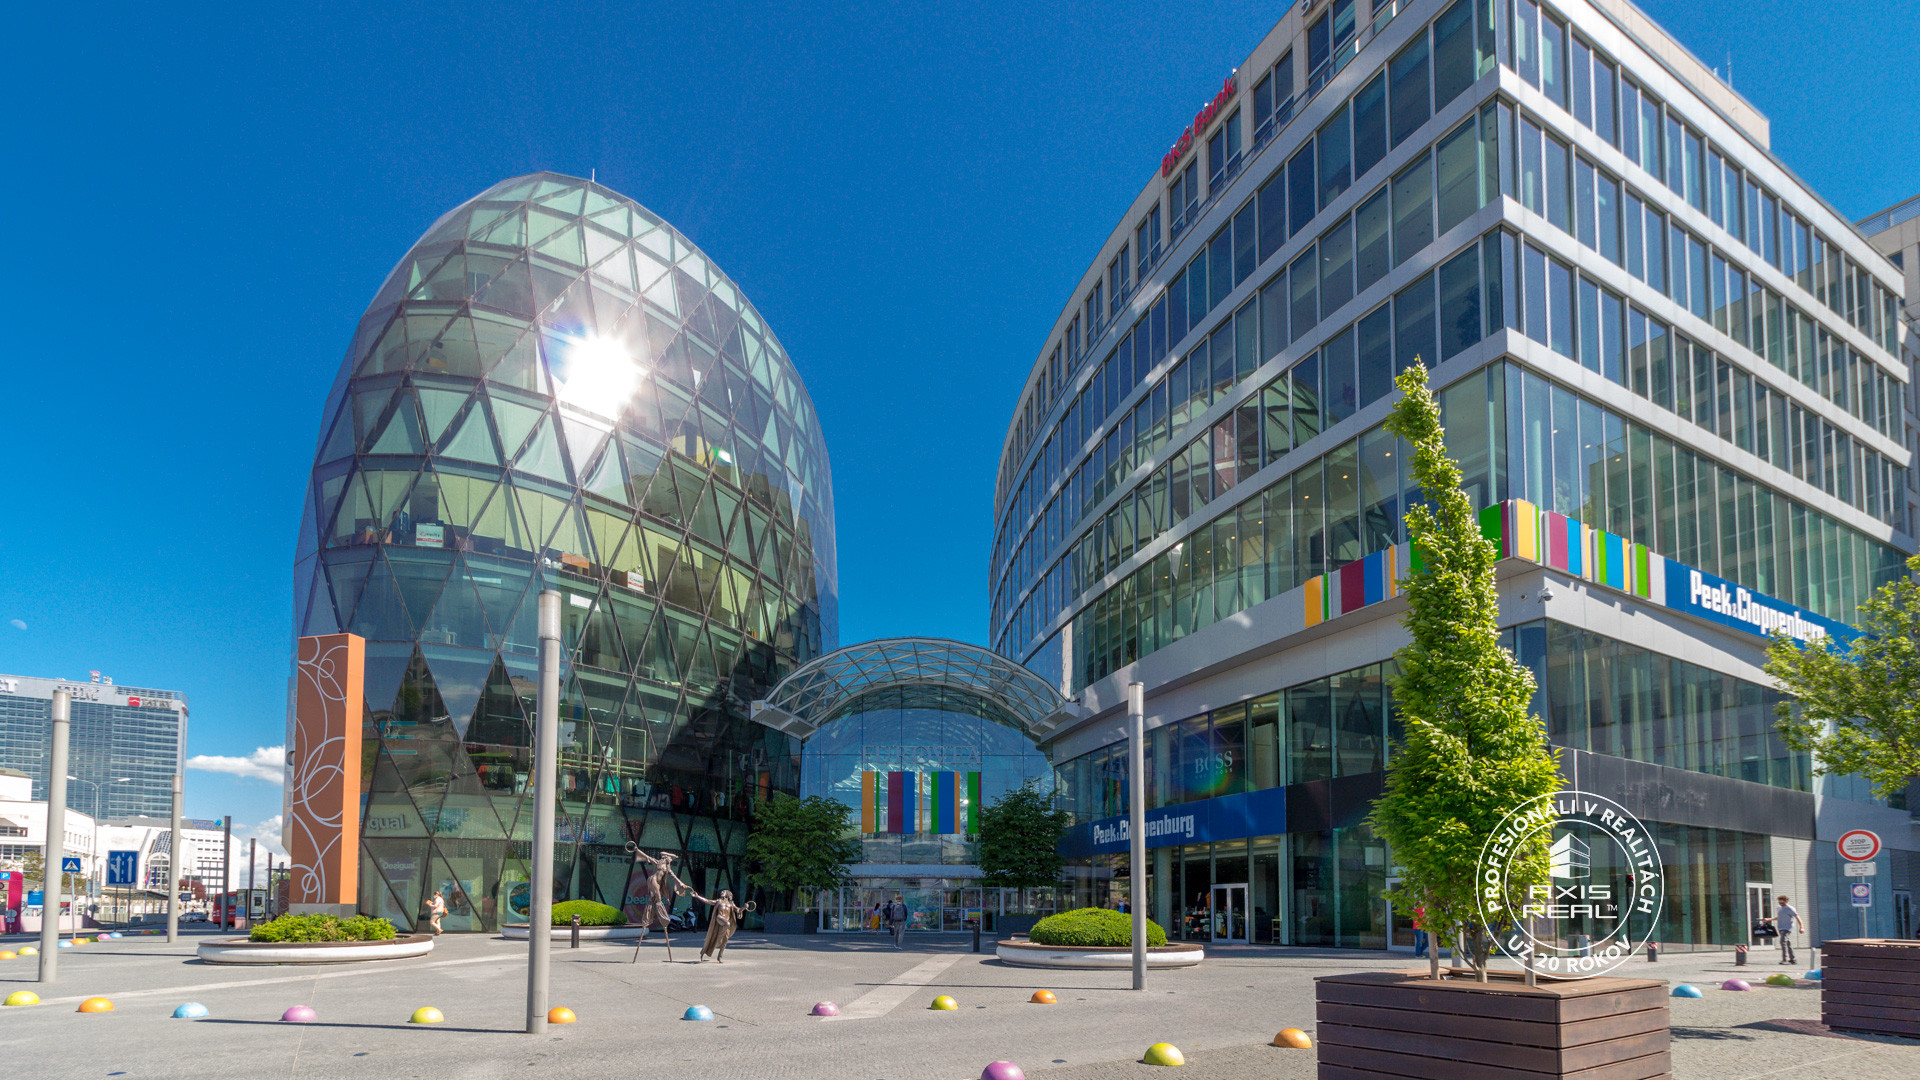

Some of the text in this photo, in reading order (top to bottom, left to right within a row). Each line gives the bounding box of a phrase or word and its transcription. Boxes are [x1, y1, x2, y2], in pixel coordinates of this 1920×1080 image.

[1162, 75, 1236, 178] BKS Bank
[861, 745, 983, 766] EUROVEA
[1093, 814, 1195, 845] Peek&Clpenburg
